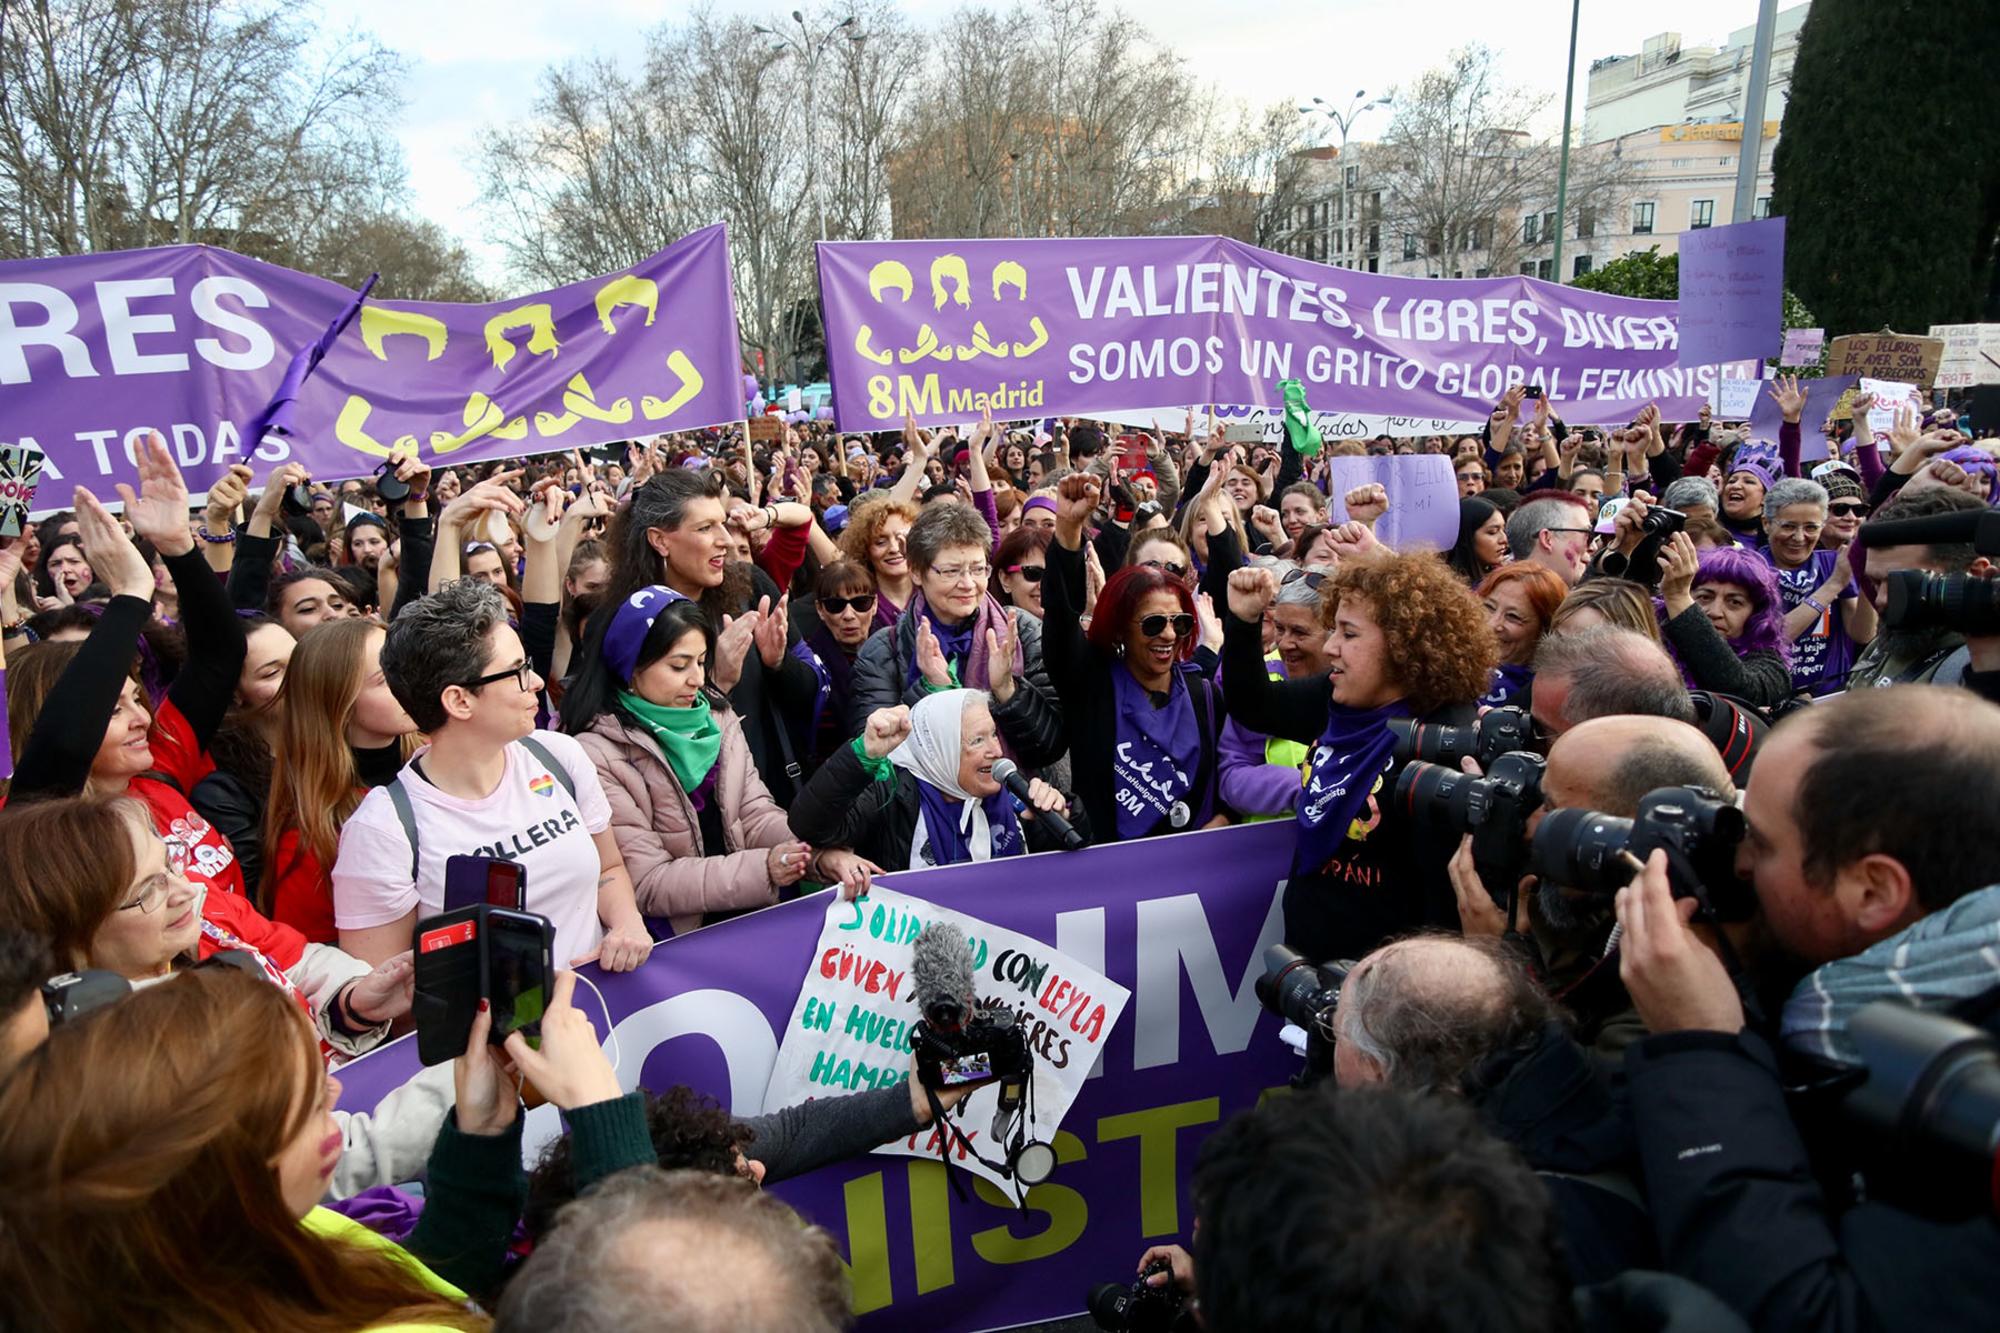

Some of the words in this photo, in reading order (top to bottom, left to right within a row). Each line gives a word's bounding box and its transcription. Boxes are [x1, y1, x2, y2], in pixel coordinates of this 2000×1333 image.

[1066, 262, 1363, 340] VALIENTES,
[1372, 296, 1547, 355] LIBRES,
[1564, 307, 1679, 351] DIVER
[1068, 335, 1224, 384] SOMOS
[1240, 338, 1293, 379] UN
[1307, 346, 1425, 390] GRITO
[1437, 362, 1570, 400] GLOBAL
[1577, 364, 1748, 401] FEMINISTA
[1845, 354, 1858, 364] DE
[1864, 354, 1891, 367] AYER
[1899, 355, 1922, 367] SON
[1849, 341, 1868, 351] LOS
[867, 372, 944, 420] 8M
[948, 381, 1044, 415] Madrid
[1872, 367, 1928, 380] DERECHOS
[75, 420, 291, 476] TODAS
[1115, 788, 1146, 817] 8M
[471, 808, 580, 861] OLLERA
[820, 943, 905, 1002] GÜVEN
[993, 949, 1049, 998] CON
[1039, 975, 1106, 1044] LEYLA
[802, 997, 836, 1034] EN
